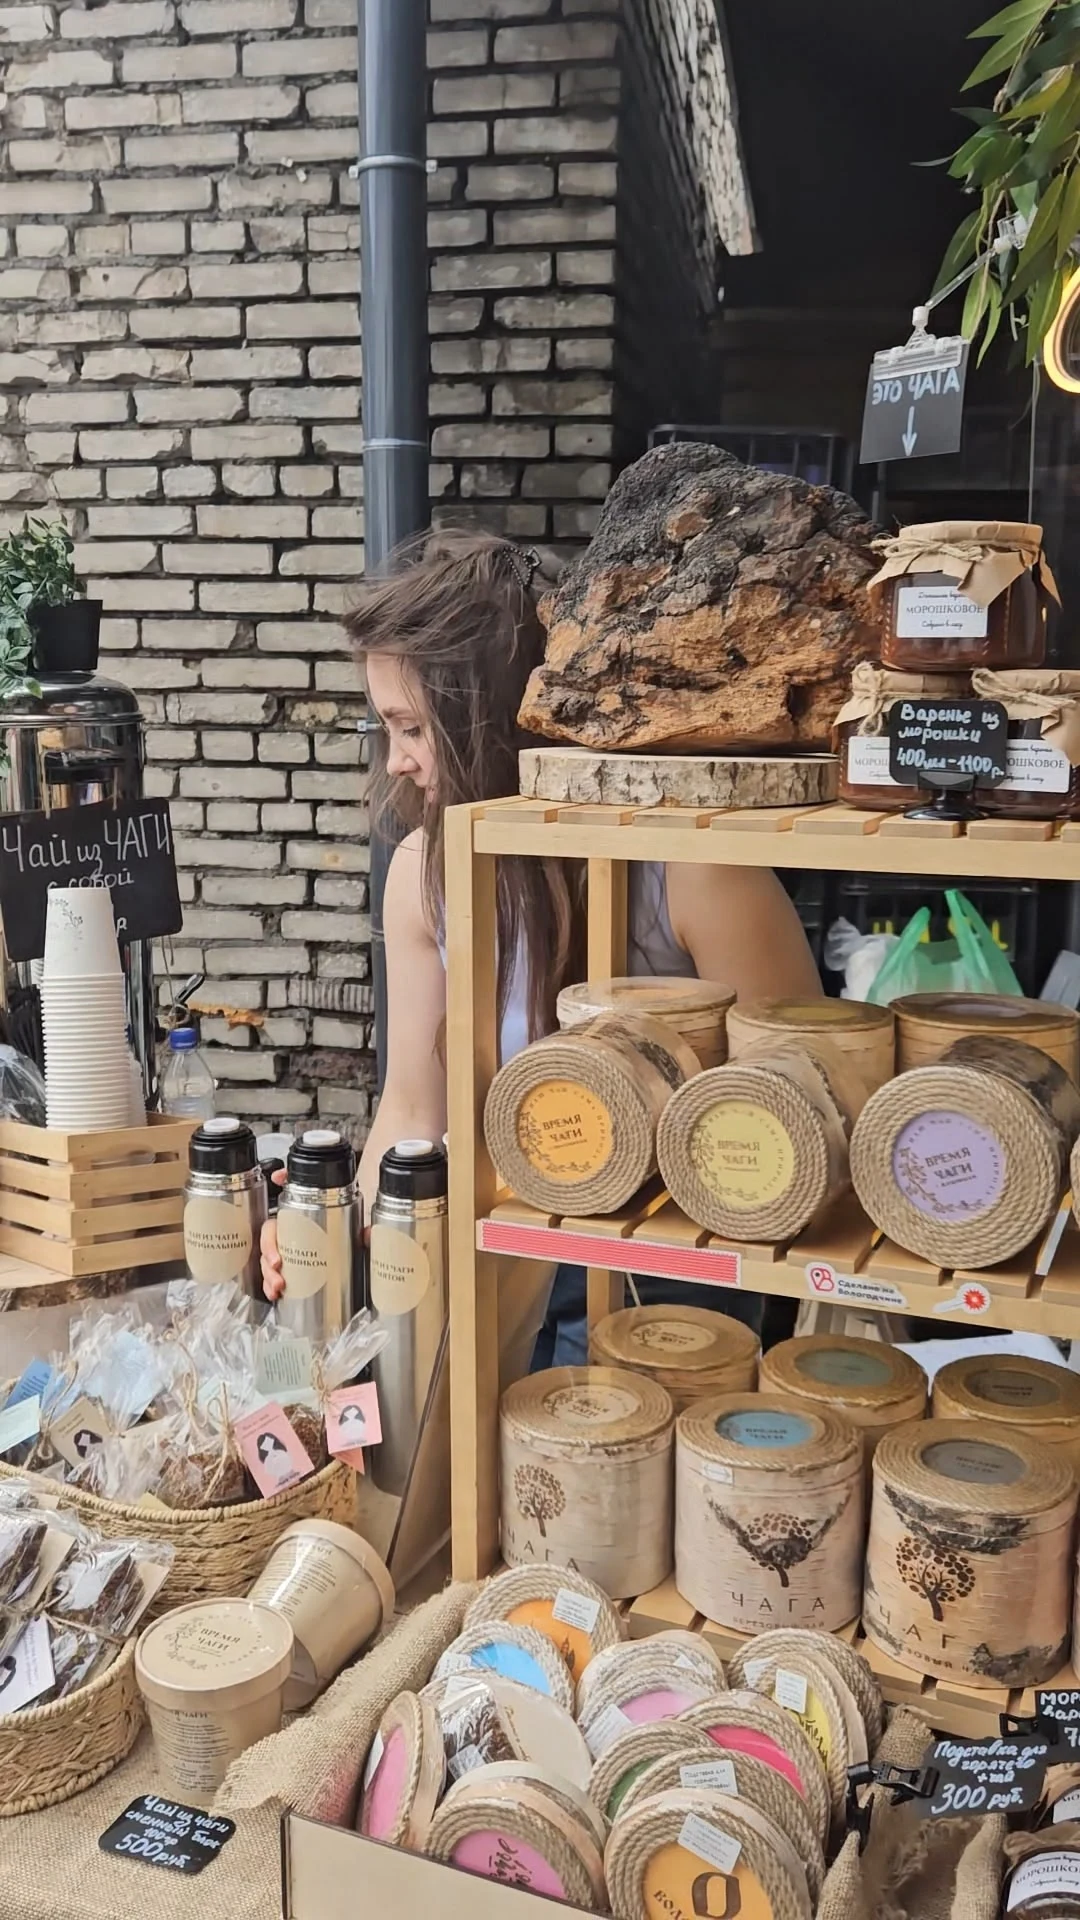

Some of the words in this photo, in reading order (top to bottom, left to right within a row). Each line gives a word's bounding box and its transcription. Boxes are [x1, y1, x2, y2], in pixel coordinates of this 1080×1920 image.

[872, 379, 903, 405] ЭТО
[908, 367, 960, 400] ЧАГА
[906, 604, 984, 614] МОРОШКОВОЕ
[900, 703, 972, 726] Варенье
[981, 711, 1000, 730] из
[898, 724, 981, 745] морошки
[854, 757, 889, 768] МОРОШ
[1007, 757, 1065, 769] ОШКОВОЕ
[2, 825, 71, 872] Чай
[77, 843, 104, 880] из
[104, 813, 171, 861] ЧАГИ
[542, 1113, 582, 1130] ВРЕМЯ
[549, 1127, 582, 1142] ЧАГИ
[717, 1140, 761, 1151] ВРЕМЯ
[721, 1154, 757, 1166] ЧАГИ
[924, 1147, 971, 1167] ВРЕМЯ
[934, 1162, 973, 1180] ЧАГИ
[838, 1279, 880, 1292] Сделано
[507, 1526, 582, 1573] ЧАГА
[731, 1591, 825, 1613] ЧАГА
[200, 1627, 241, 1644] ВРЕМЯ
[879, 1604, 994, 1662] ЧАГА
[198, 1636, 230, 1651] ЧАГИ
[1040, 1692, 1080, 1706] МОР
[1042, 1704, 1080, 1722] вар
[1064, 1727, 1080, 1748] 7
[934, 1739, 1018, 1767] Подставка
[1021, 1744, 1047, 1762] для
[961, 1756, 1036, 1774] горячего
[931, 1783, 987, 1815] 300
[987, 1787, 1024, 1810] руб.
[125, 1810, 190, 1837] сменный
[143, 1795, 179, 1817] Чай
[176, 1811, 193, 1829] из
[195, 1815, 229, 1833] чаги
[1016, 1864, 1080, 1884] МОРОШКОВ
[653, 1889, 690, 1920] ВОЛ
